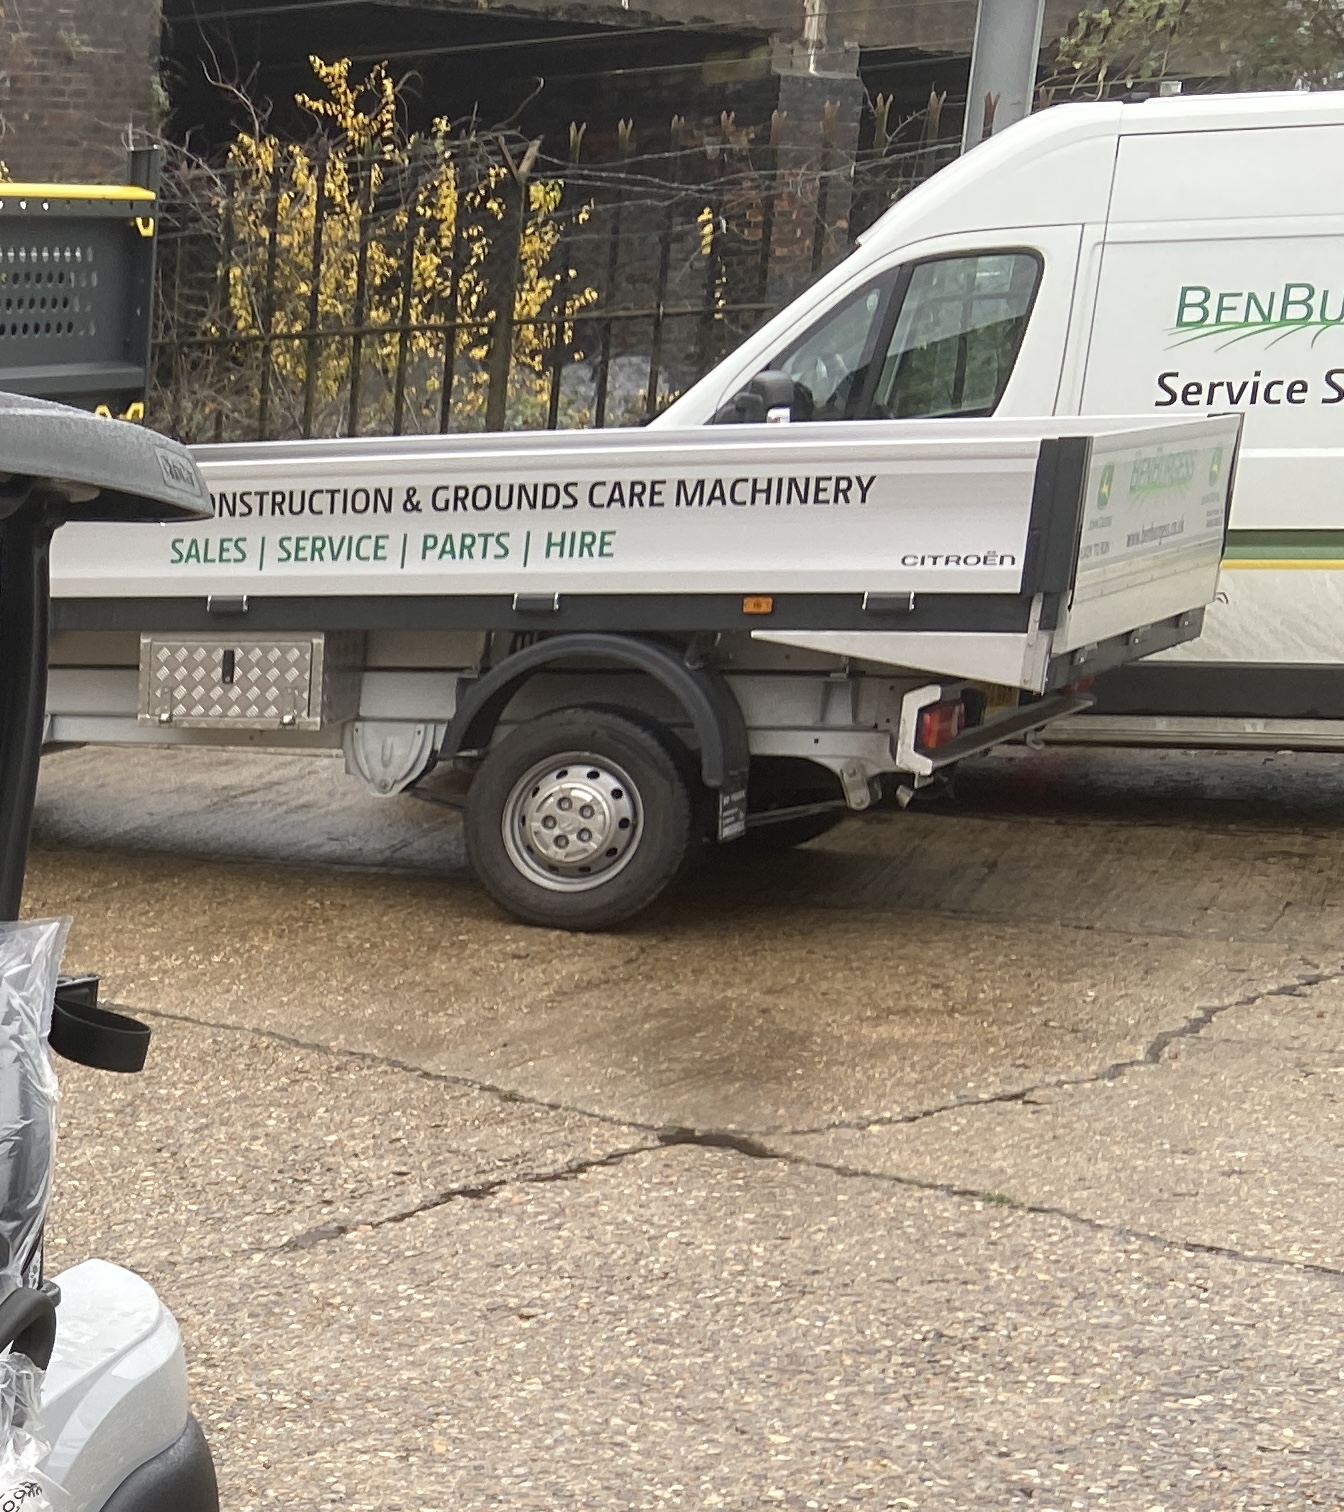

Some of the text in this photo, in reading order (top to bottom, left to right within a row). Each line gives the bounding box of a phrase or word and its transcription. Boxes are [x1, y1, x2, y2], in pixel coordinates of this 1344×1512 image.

[1155, 370, 1309, 406] Service
[210, 475, 877, 518] NSTRUCTION & GROUNDS CARE MACHINERY
[170, 530, 616, 564] SALES SERVICE PARTS HIRE
[901, 551, 1016, 566] CITROËN
